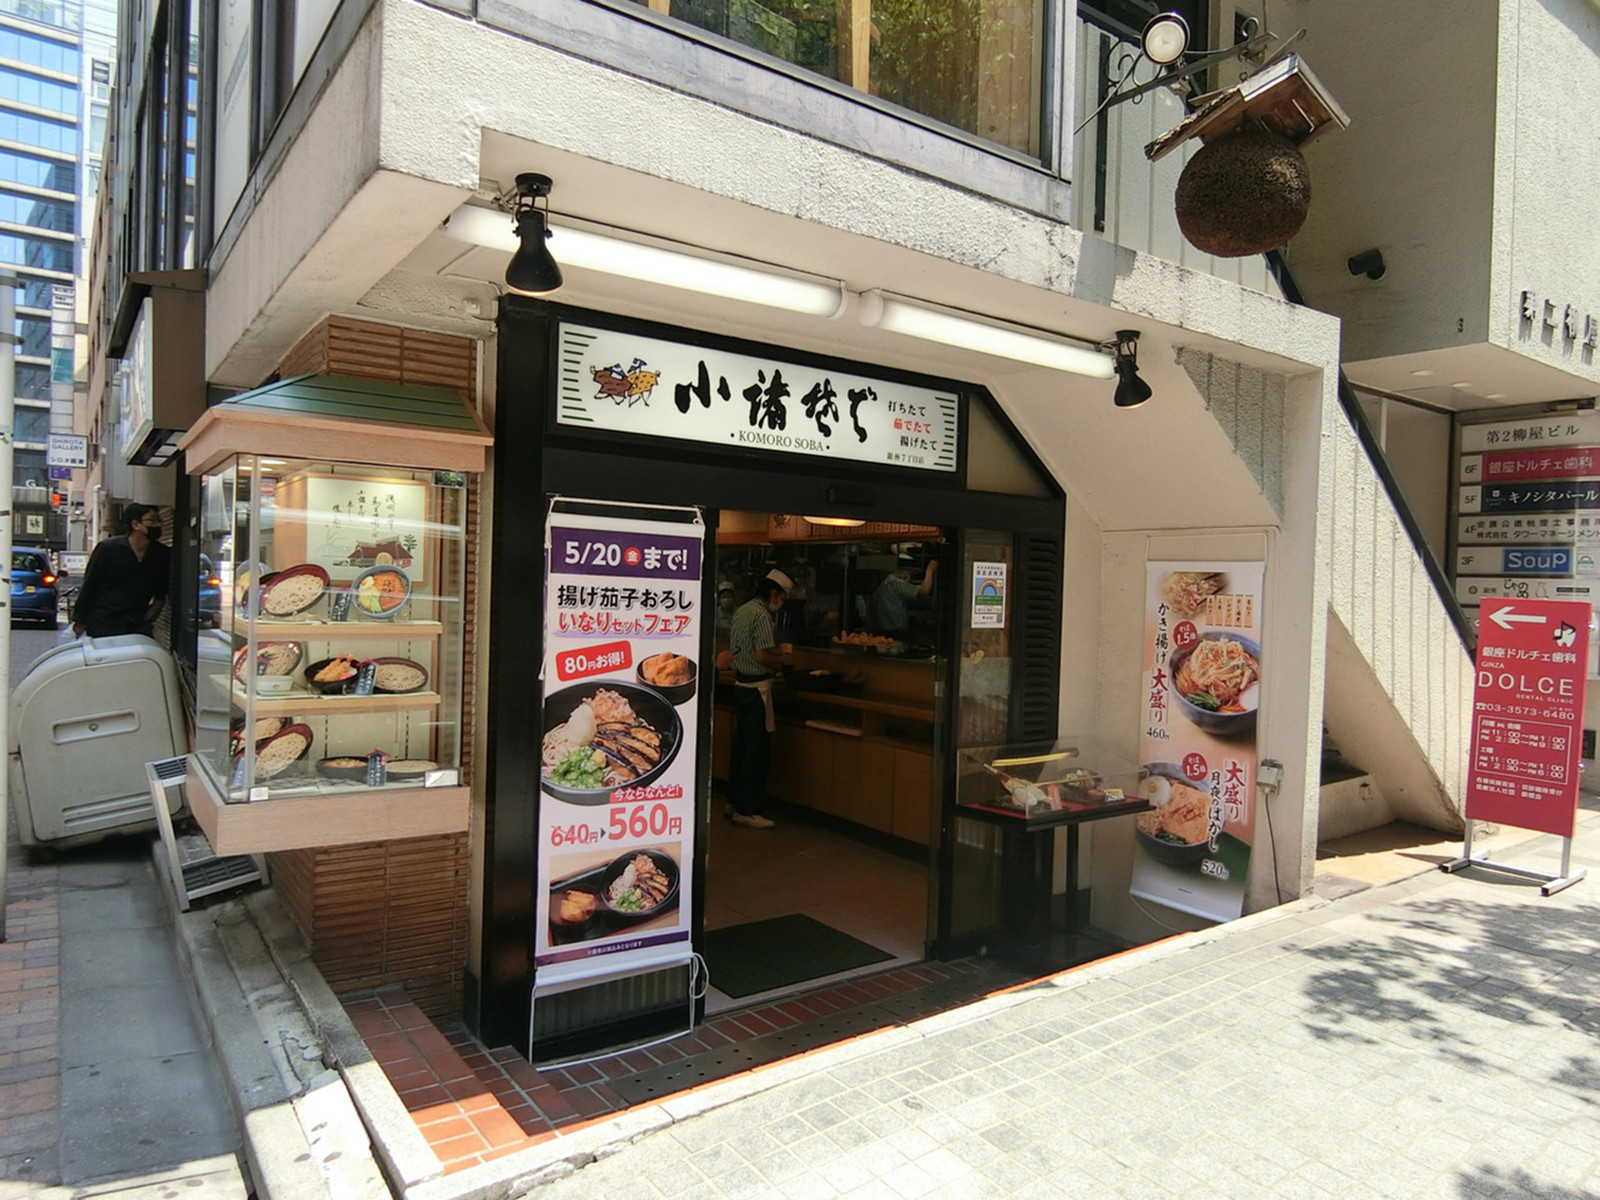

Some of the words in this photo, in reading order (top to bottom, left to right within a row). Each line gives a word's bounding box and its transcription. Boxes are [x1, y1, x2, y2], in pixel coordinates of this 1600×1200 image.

[888, 400, 926, 417] 打ちたて
[893, 417, 932, 433] 茹でたて
[738, 430, 793, 448] KOMORO
[794, 438, 825, 452] SOBA
[900, 435, 938, 451] 揚げたて
[1486, 425, 1580, 444] 第2柳屋ビル
[1464, 464, 1477, 474] 6F
[1488, 456, 1593, 474] 銀座ドルチェ歯科
[1464, 495, 1477, 503] 5F
[1508, 489, 1599, 504] キノシタバール
[1464, 525, 1476, 535] 4F
[565, 541, 621, 567] 5/20
[643, 546, 688, 571] まで!
[1461, 556, 1474, 565] 3F
[1508, 552, 1567, 569] Soup
[557, 584, 693, 610] 揚げ茄子おろし
[558, 611, 691, 634] いなりセットフェア
[564, 650, 625, 674] 80円お得!
[1482, 645, 1577, 665] 銀座ドルチェ歯科
[1481, 661, 1505, 669] GINZA
[1478, 671, 1575, 697] DOLCE
[1516, 694, 1544, 702] DENTAL
[1546, 696, 1574, 705] CLINIC
[1486, 702, 1575, 721] 03-3573-6480
[613, 785, 681, 801] 今ならなんと!
[1223, 761, 1246, 820] 大盛り
[1208, 771, 1223, 852] 月夜のばかし
[608, 803, 682, 840] 560円
[551, 824, 598, 847] 640円
